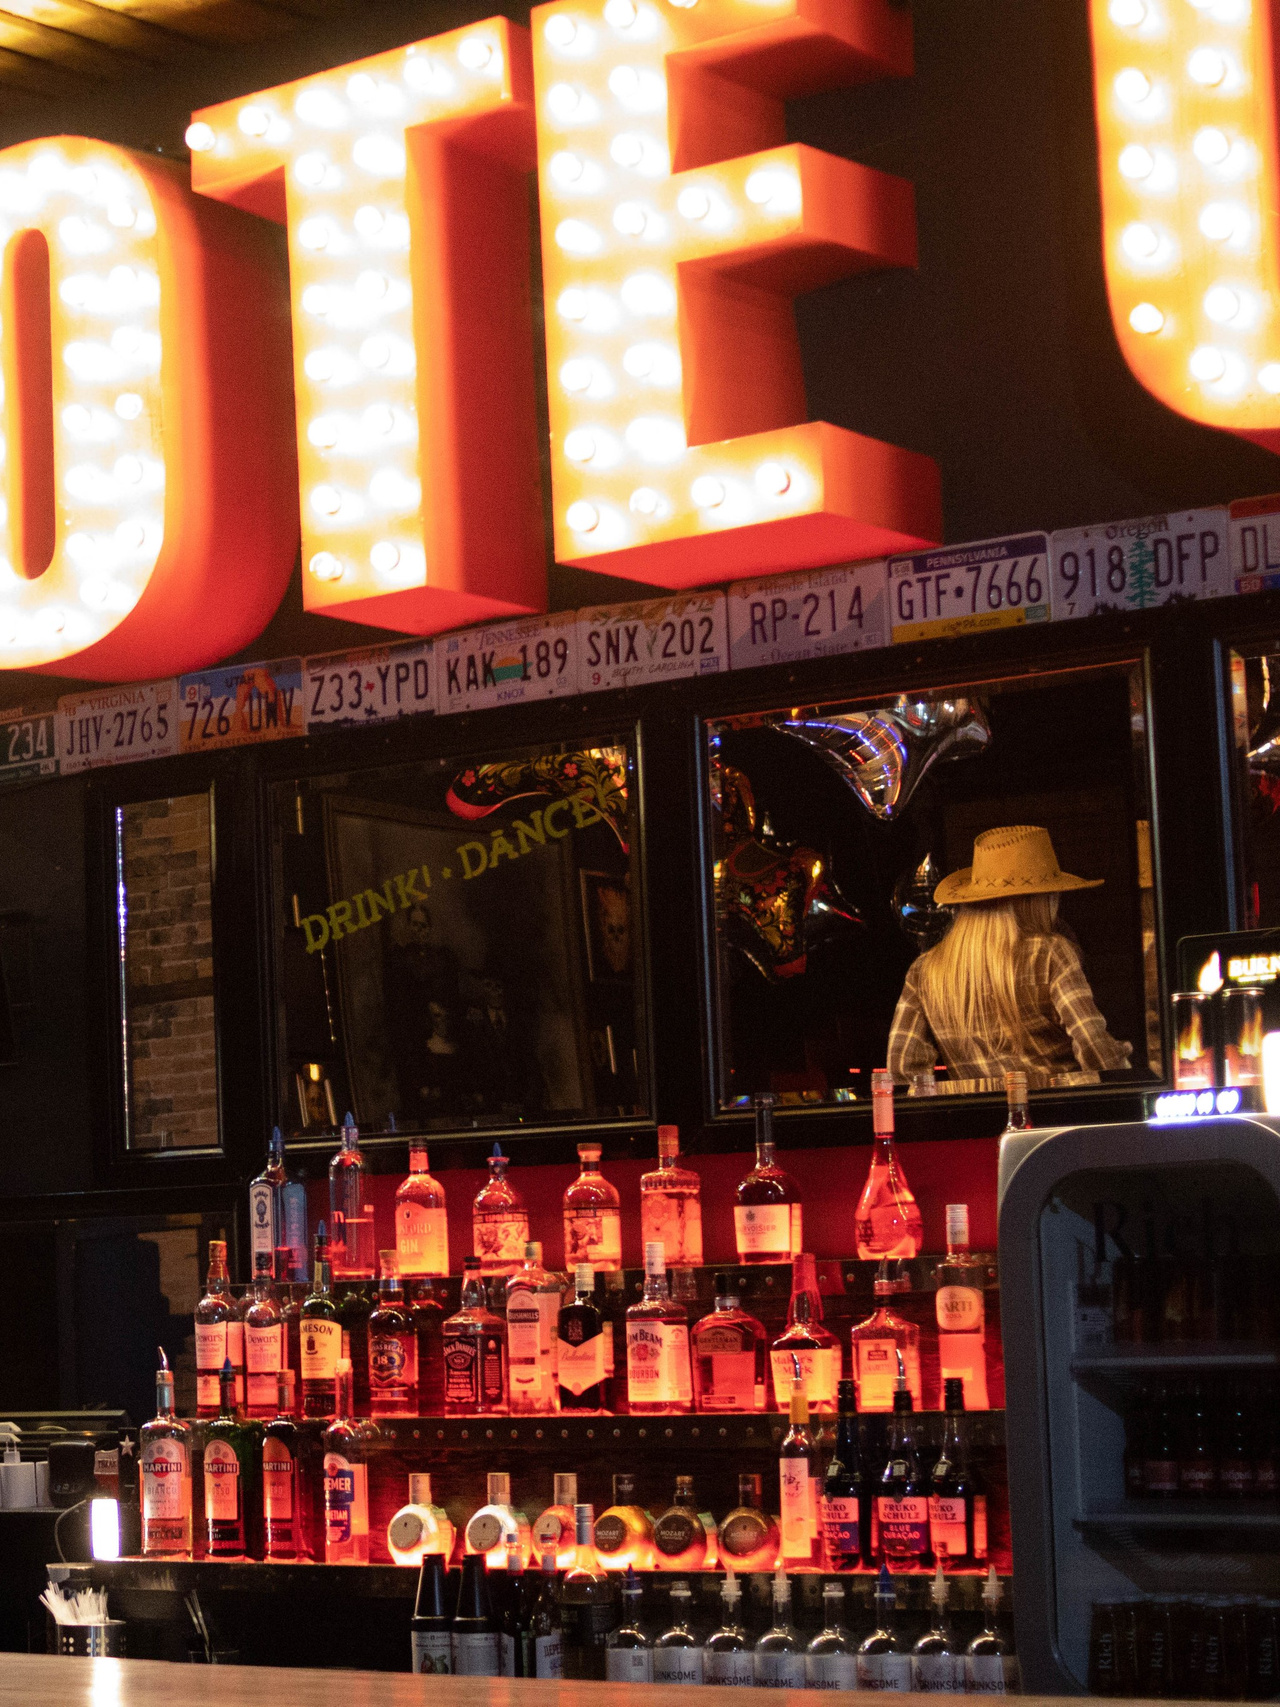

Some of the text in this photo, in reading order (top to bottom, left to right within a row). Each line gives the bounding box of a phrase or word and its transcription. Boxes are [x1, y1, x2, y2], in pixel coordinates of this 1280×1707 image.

[925, 546, 1009, 569] PENNSYLVANIA
[1059, 530, 1220, 600] 918 DFP
[749, 586, 864, 645] RP-214
[586, 616, 715, 667] SNX 202
[445, 637, 568, 696] KAK 189
[185, 697, 231, 741] 726
[7, 720, 48, 763] 234
[143, 1462, 182, 1472] MARTINI
[204, 1462, 238, 1473] MARTINI
